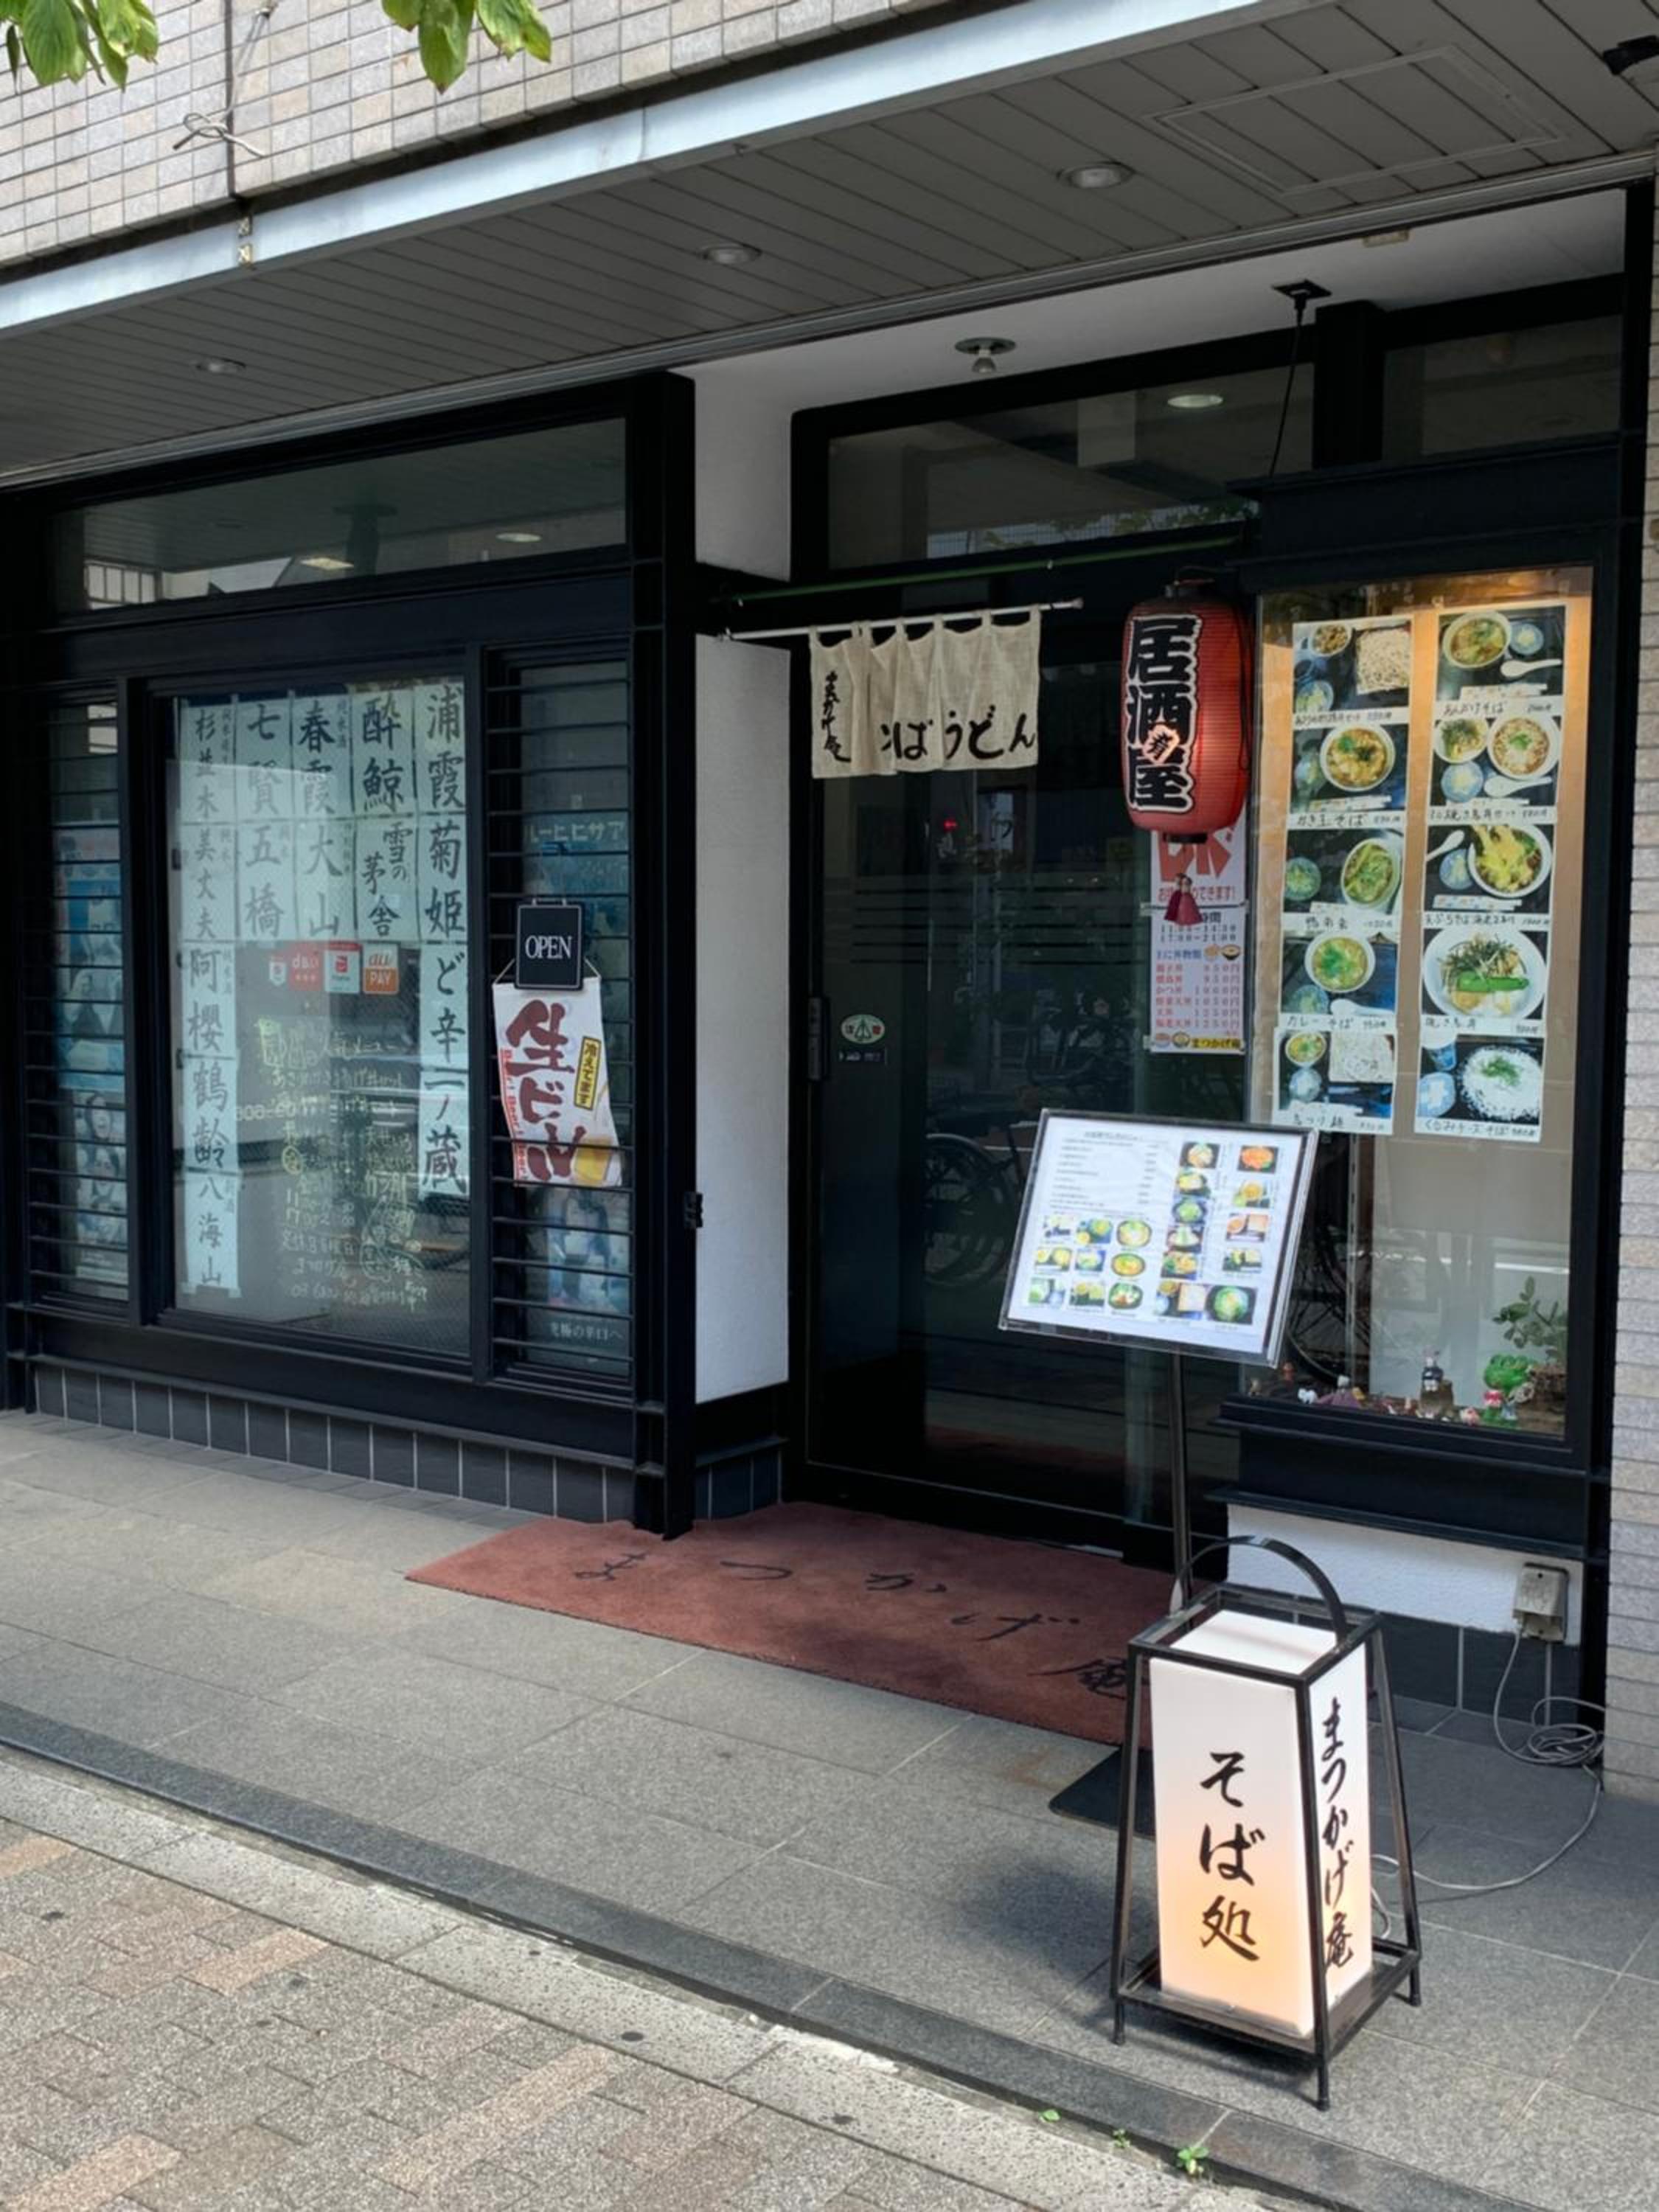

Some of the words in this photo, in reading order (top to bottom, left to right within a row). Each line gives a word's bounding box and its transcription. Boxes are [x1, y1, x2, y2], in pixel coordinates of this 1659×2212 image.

[247, 703, 282, 814] 七賢
[298, 700, 337, 814] 春霞
[362, 693, 405, 813] 酔鯨
[426, 685, 465, 810] 浦霞
[1127, 616, 1198, 810] 居酒屋
[245, 825, 285, 939] 五橋
[305, 825, 344, 937] 大山
[424, 819, 466, 936] 菊姫
[369, 970, 392, 985] PAY
[525, 935, 572, 959] OPEN
[430, 952, 467, 1063] ど辛
[422, 1075, 468, 1193] 一ノ蔵
[198, 1176, 224, 1284] 八海山
[1200, 1751, 1265, 1962] そば処
[1321, 1697, 1354, 1972] まつかげ庵
